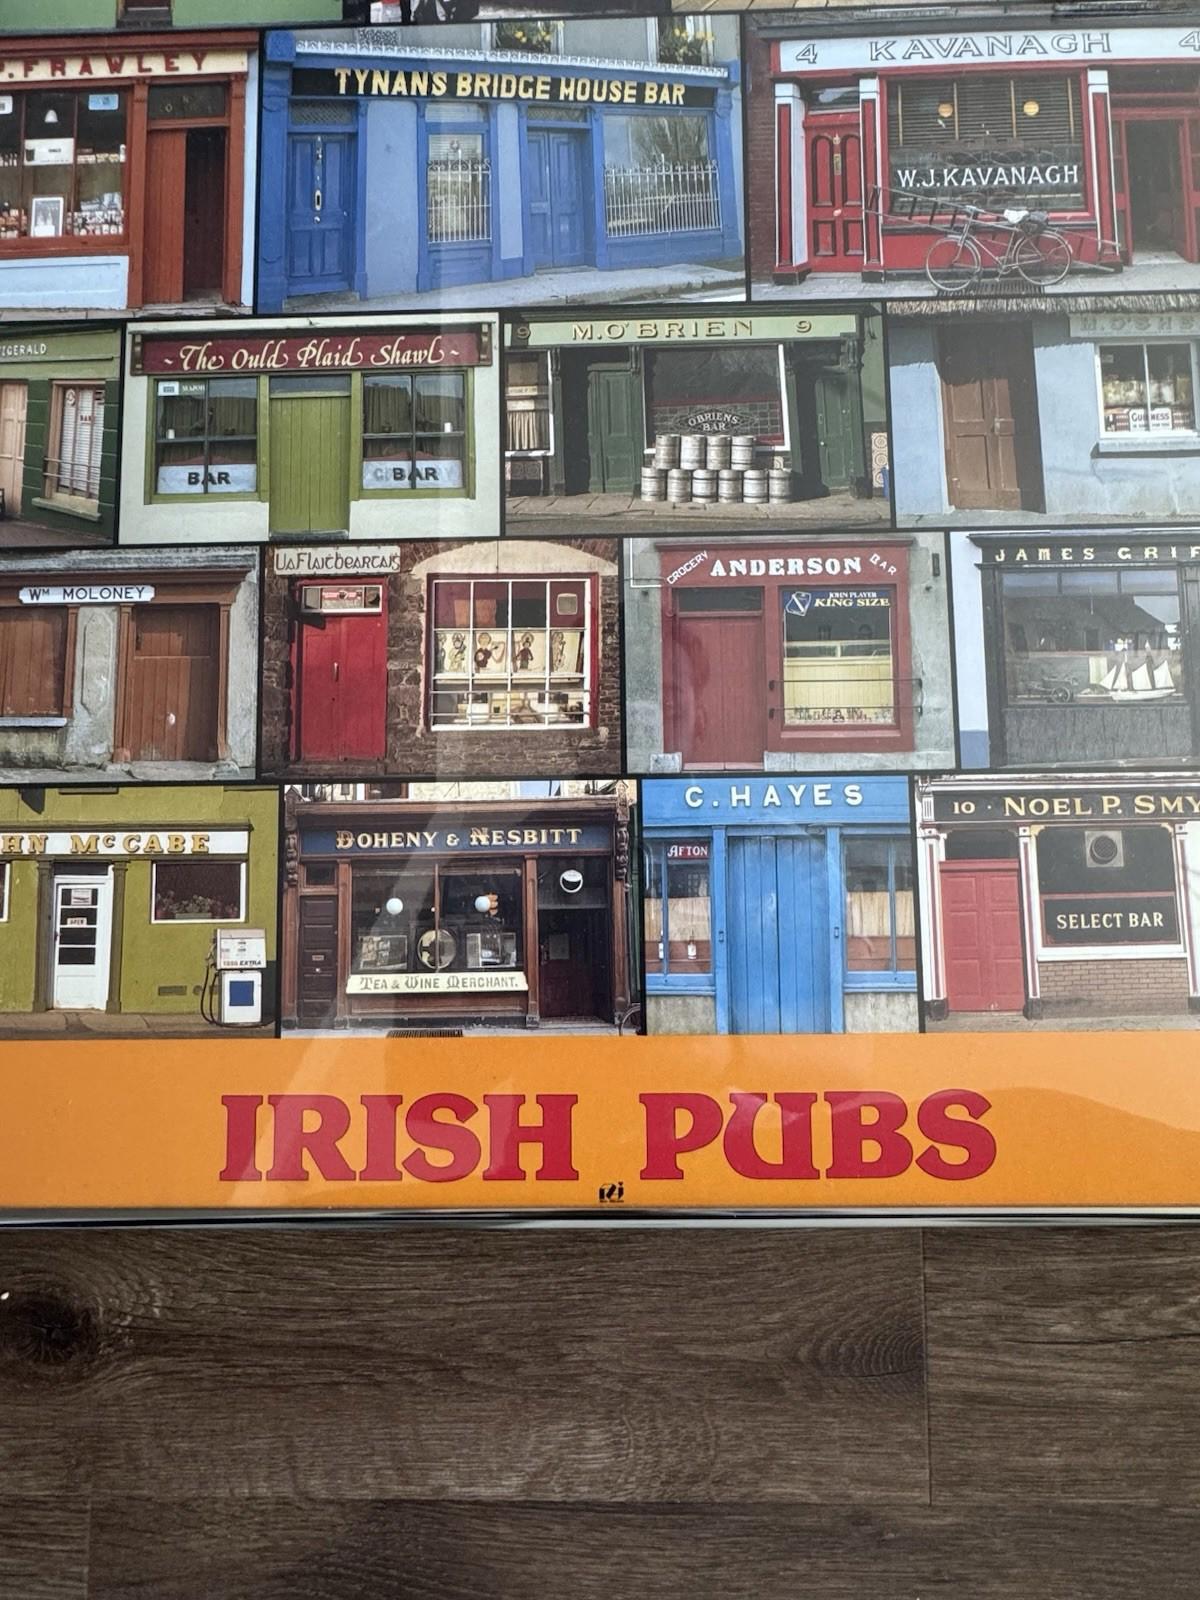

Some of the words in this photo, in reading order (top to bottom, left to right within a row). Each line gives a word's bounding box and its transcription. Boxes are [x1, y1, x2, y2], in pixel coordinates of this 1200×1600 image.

[795, 43, 818, 66] 4
[869, 32, 1112, 62] KAVANAGH
[335, 67, 448, 97] TYNANS
[456, 73, 551, 100] BRIDGE
[559, 76, 638, 104] HOUSE
[644, 81, 686, 105] BAR
[795, 319, 813, 334] 9
[180, 341, 224, 371] The
[231, 340, 289, 370] Ould
[297, 337, 363, 368] Plaid
[370, 335, 445, 366] Shawl
[702, 422, 727, 432] BAR
[188, 470, 231, 486] BAR
[392, 466, 440, 482] BAR
[995, 547, 1095, 562] JAMES
[1117, 546, 1200, 560] GRIF
[666, 550, 709, 584] GROCERY
[710, 556, 862, 578] ANDERSON
[869, 553, 897, 577] BAR
[63, 587, 145, 601] MOLONEY
[814, 598, 854, 607] KING
[857, 598, 890, 607] SIZE
[1004, 797, 1092, 816] NOEL
[1102, 795, 1123, 815] P.
[1134, 794, 1200, 814] SMY
[336, 830, 439, 849] DOHENY
[446, 833, 460, 847] &
[470, 827, 582, 847] NESBITT
[668, 844, 708, 857] AFTON
[1056, 913, 1122, 929] SELECT
[1129, 912, 1164, 928] BAR
[360, 976, 388, 991] TEA
[405, 975, 440, 989] WINE
[219, 1093, 580, 1182] IRISH
[639, 1089, 997, 1181] PUBS
